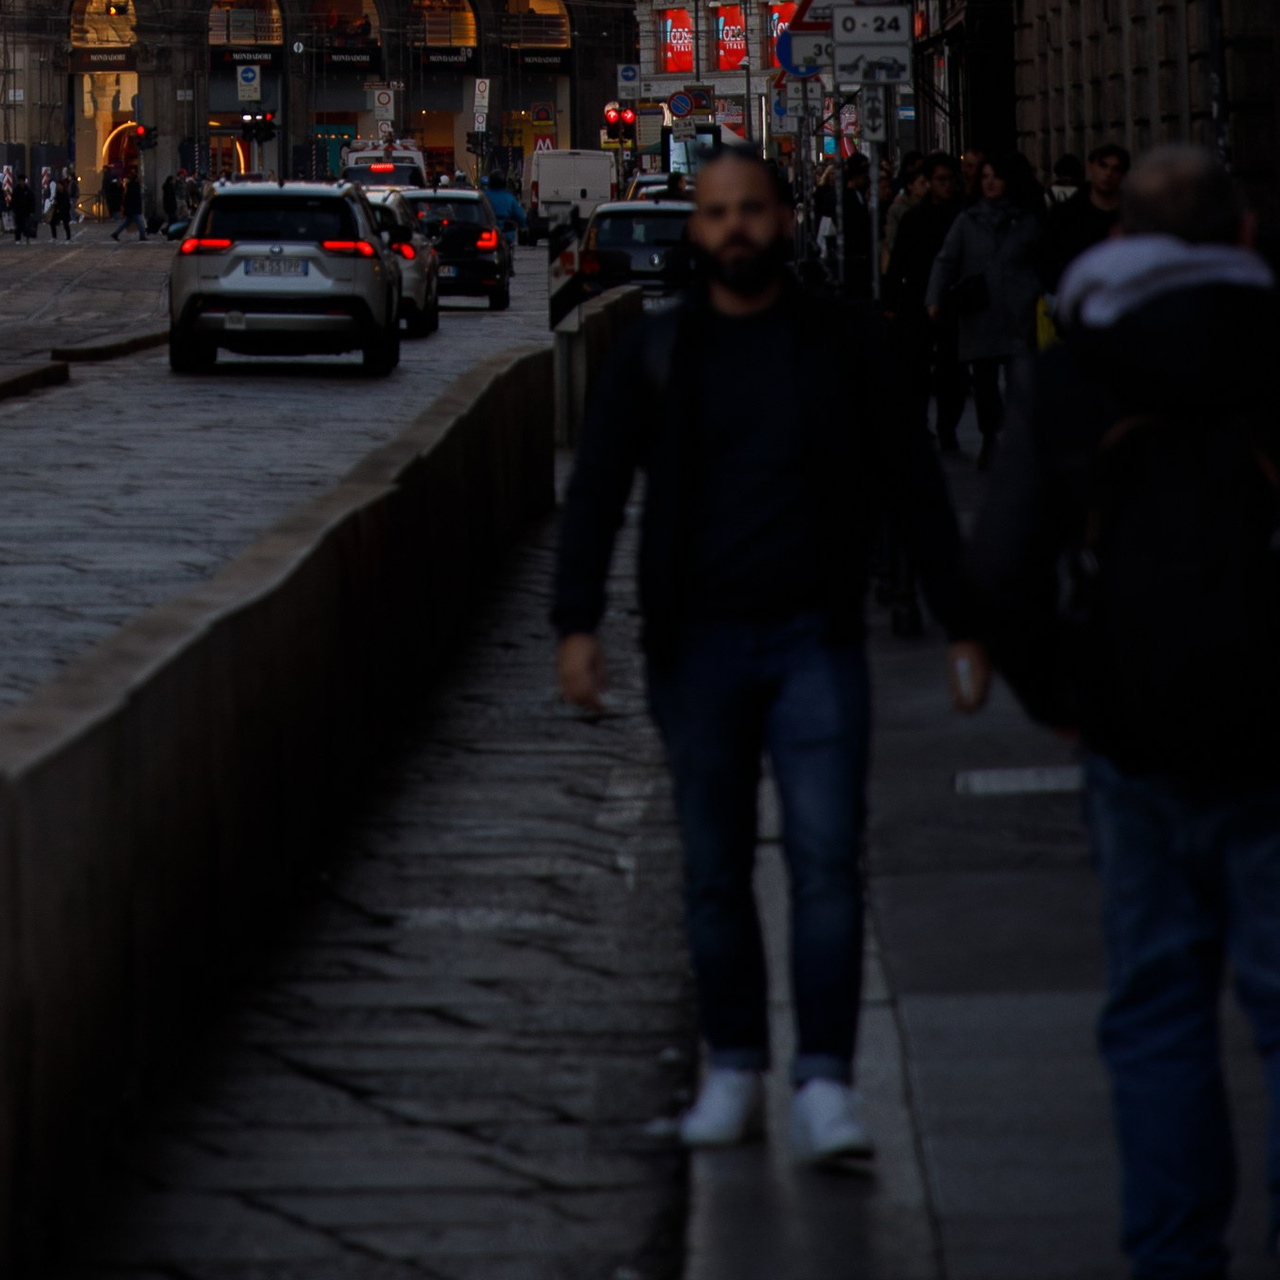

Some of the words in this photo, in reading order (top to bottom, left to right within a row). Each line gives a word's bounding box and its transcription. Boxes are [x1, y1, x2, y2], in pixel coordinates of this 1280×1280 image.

[842, 16, 855, 32] 0
[873, 16, 900, 32] 24
[90, 53, 126, 62] MONDADORI
[232, 52, 272, 61] MONDADORI
[331, 54, 370, 62] MONDADORI
[429, 55, 467, 63] MONDADORI
[524, 56, 561, 64] MONDADORI
